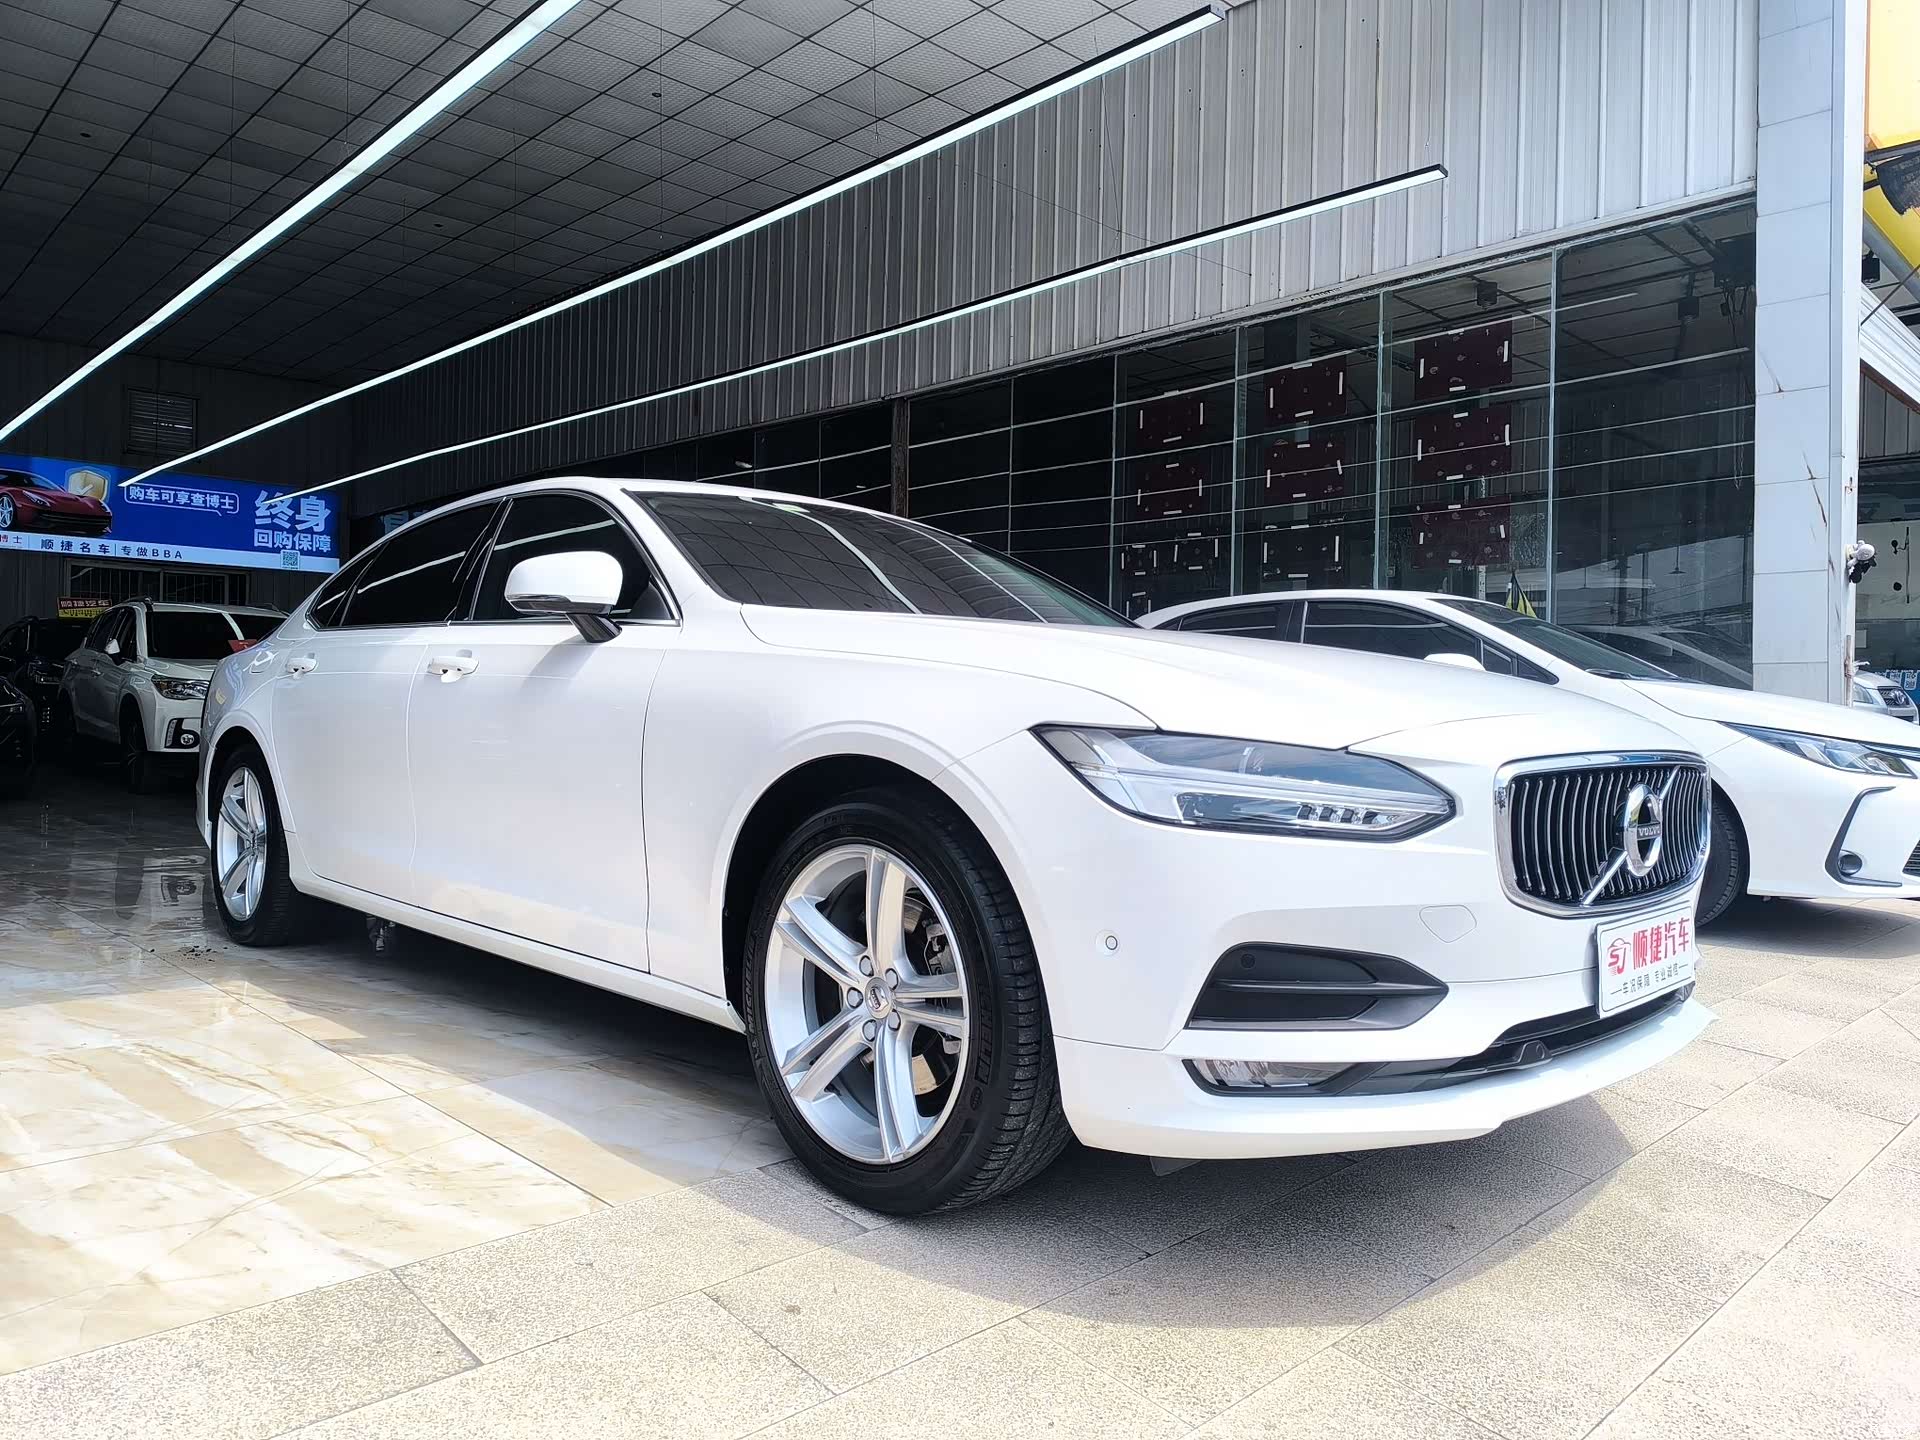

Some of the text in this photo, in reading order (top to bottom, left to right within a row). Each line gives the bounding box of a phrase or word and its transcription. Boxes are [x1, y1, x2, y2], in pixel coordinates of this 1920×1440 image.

[129, 486, 235, 511] 购车可享查博士
[254, 490, 331, 532] 终身
[40, 538, 110, 555] 顺捷名车
[253, 528, 331, 553] 回购保障
[1632, 917, 1690, 970] 顺捷汽车
